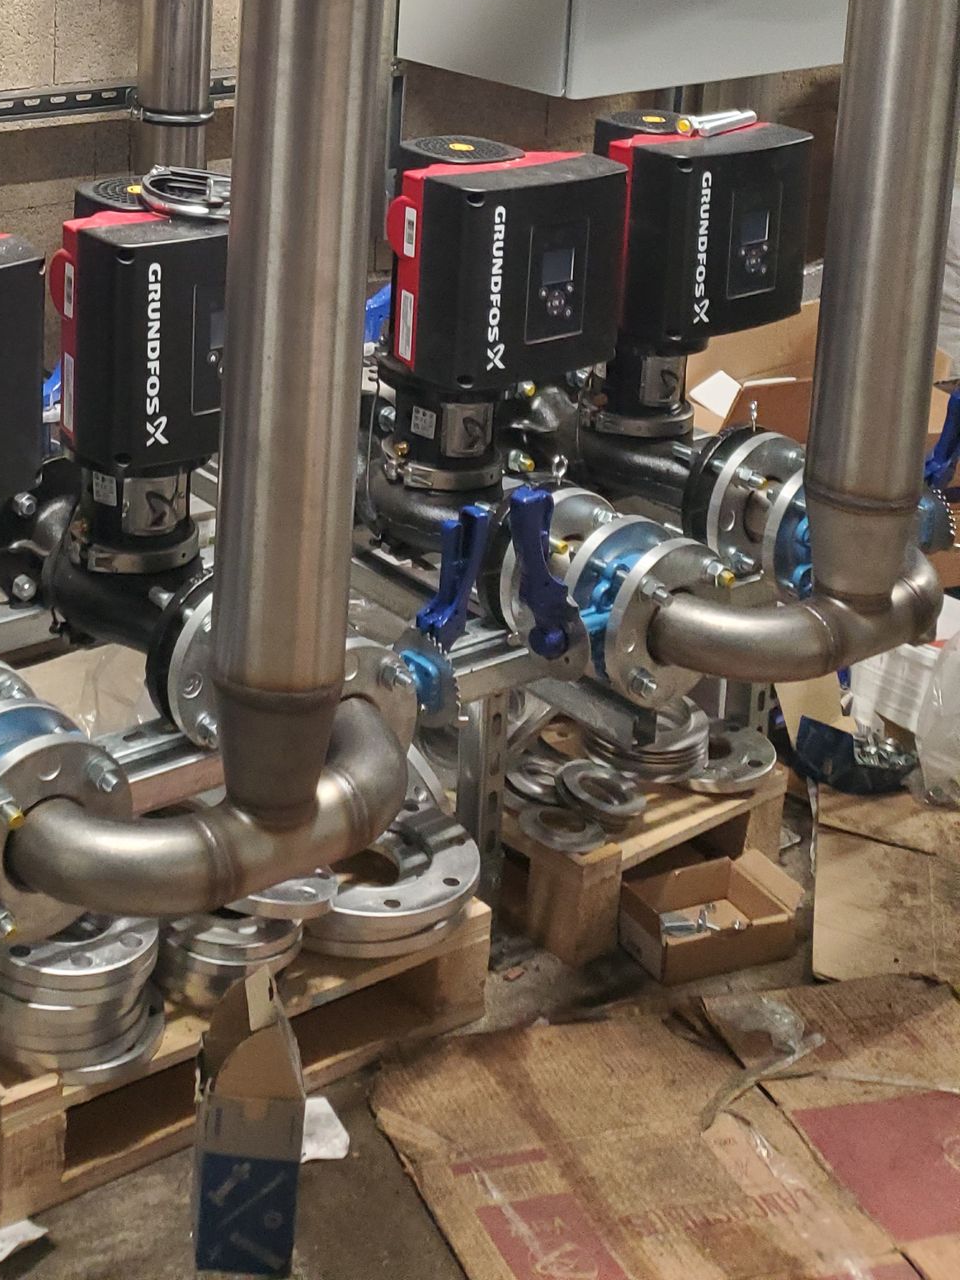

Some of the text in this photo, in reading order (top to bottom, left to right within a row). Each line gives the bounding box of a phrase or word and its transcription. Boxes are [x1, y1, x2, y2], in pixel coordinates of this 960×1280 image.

[487, 205, 506, 343] GRUNDFOS
[694, 170, 712, 298] GRUNDFOS
[145, 261, 162, 416] GRUNDFOS
